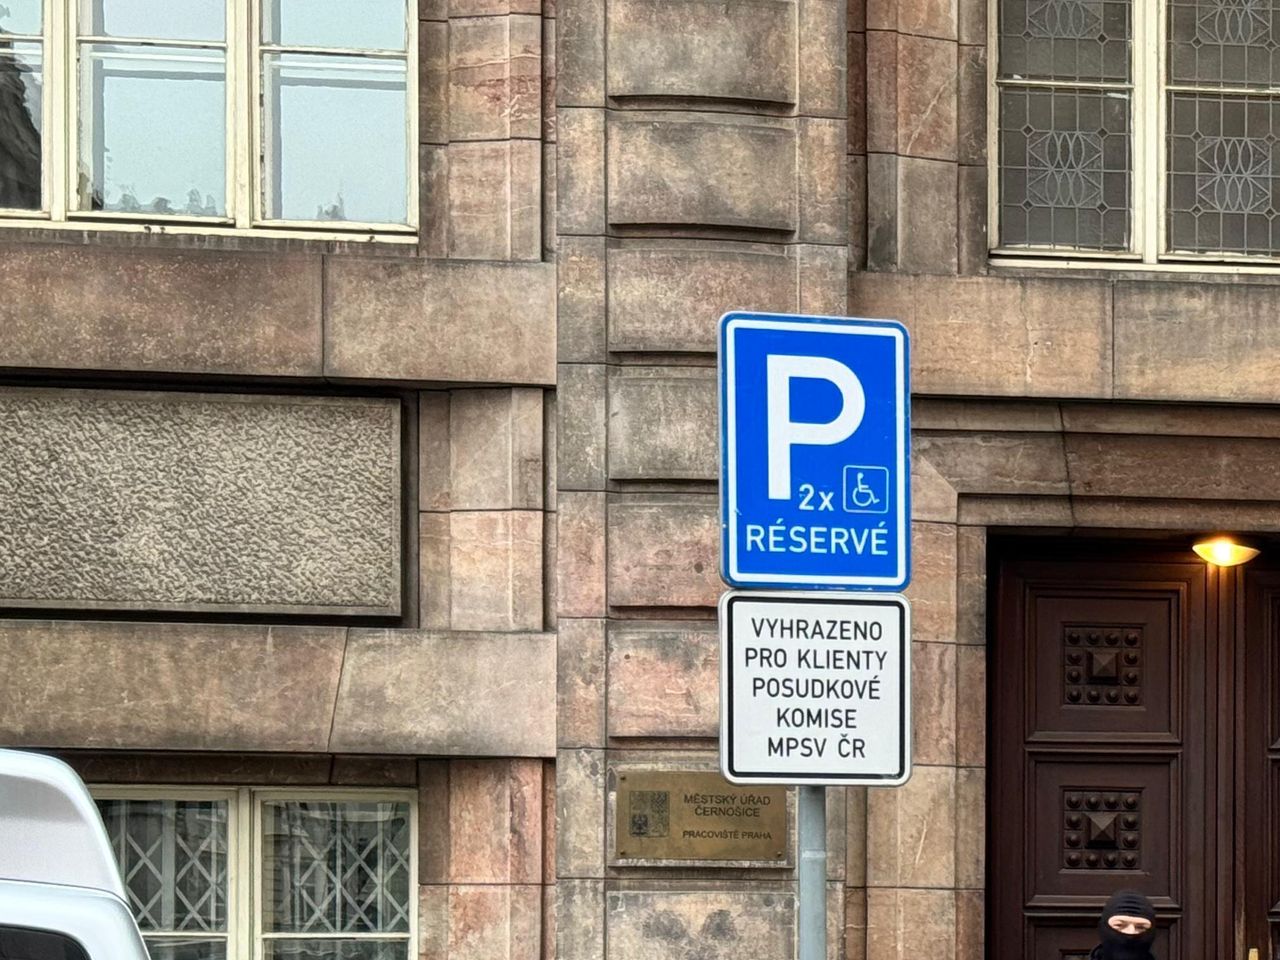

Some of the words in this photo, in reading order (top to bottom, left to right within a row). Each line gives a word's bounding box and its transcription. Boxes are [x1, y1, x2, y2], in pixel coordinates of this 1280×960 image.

[766, 354, 866, 500] P
[798, 483, 835, 512] 2x
[746, 517, 889, 556] RÉSERVÉ
[751, 617, 883, 641] VYHRAZENO
[745, 647, 788, 668] PRO
[797, 648, 888, 671] KLIENTY
[752, 675, 881, 700] POSUDKOVÉ
[776, 707, 858, 729] KOMISE
[767, 736, 828, 758] MPSV
[837, 732, 866, 759] ČR
[684, 793, 737, 805] MĚSTSKÝ
[740, 793, 772, 806] ÚŘAD
[694, 804, 761, 818] ČERNOŠICE
[741, 830, 773, 841] PRAHA
